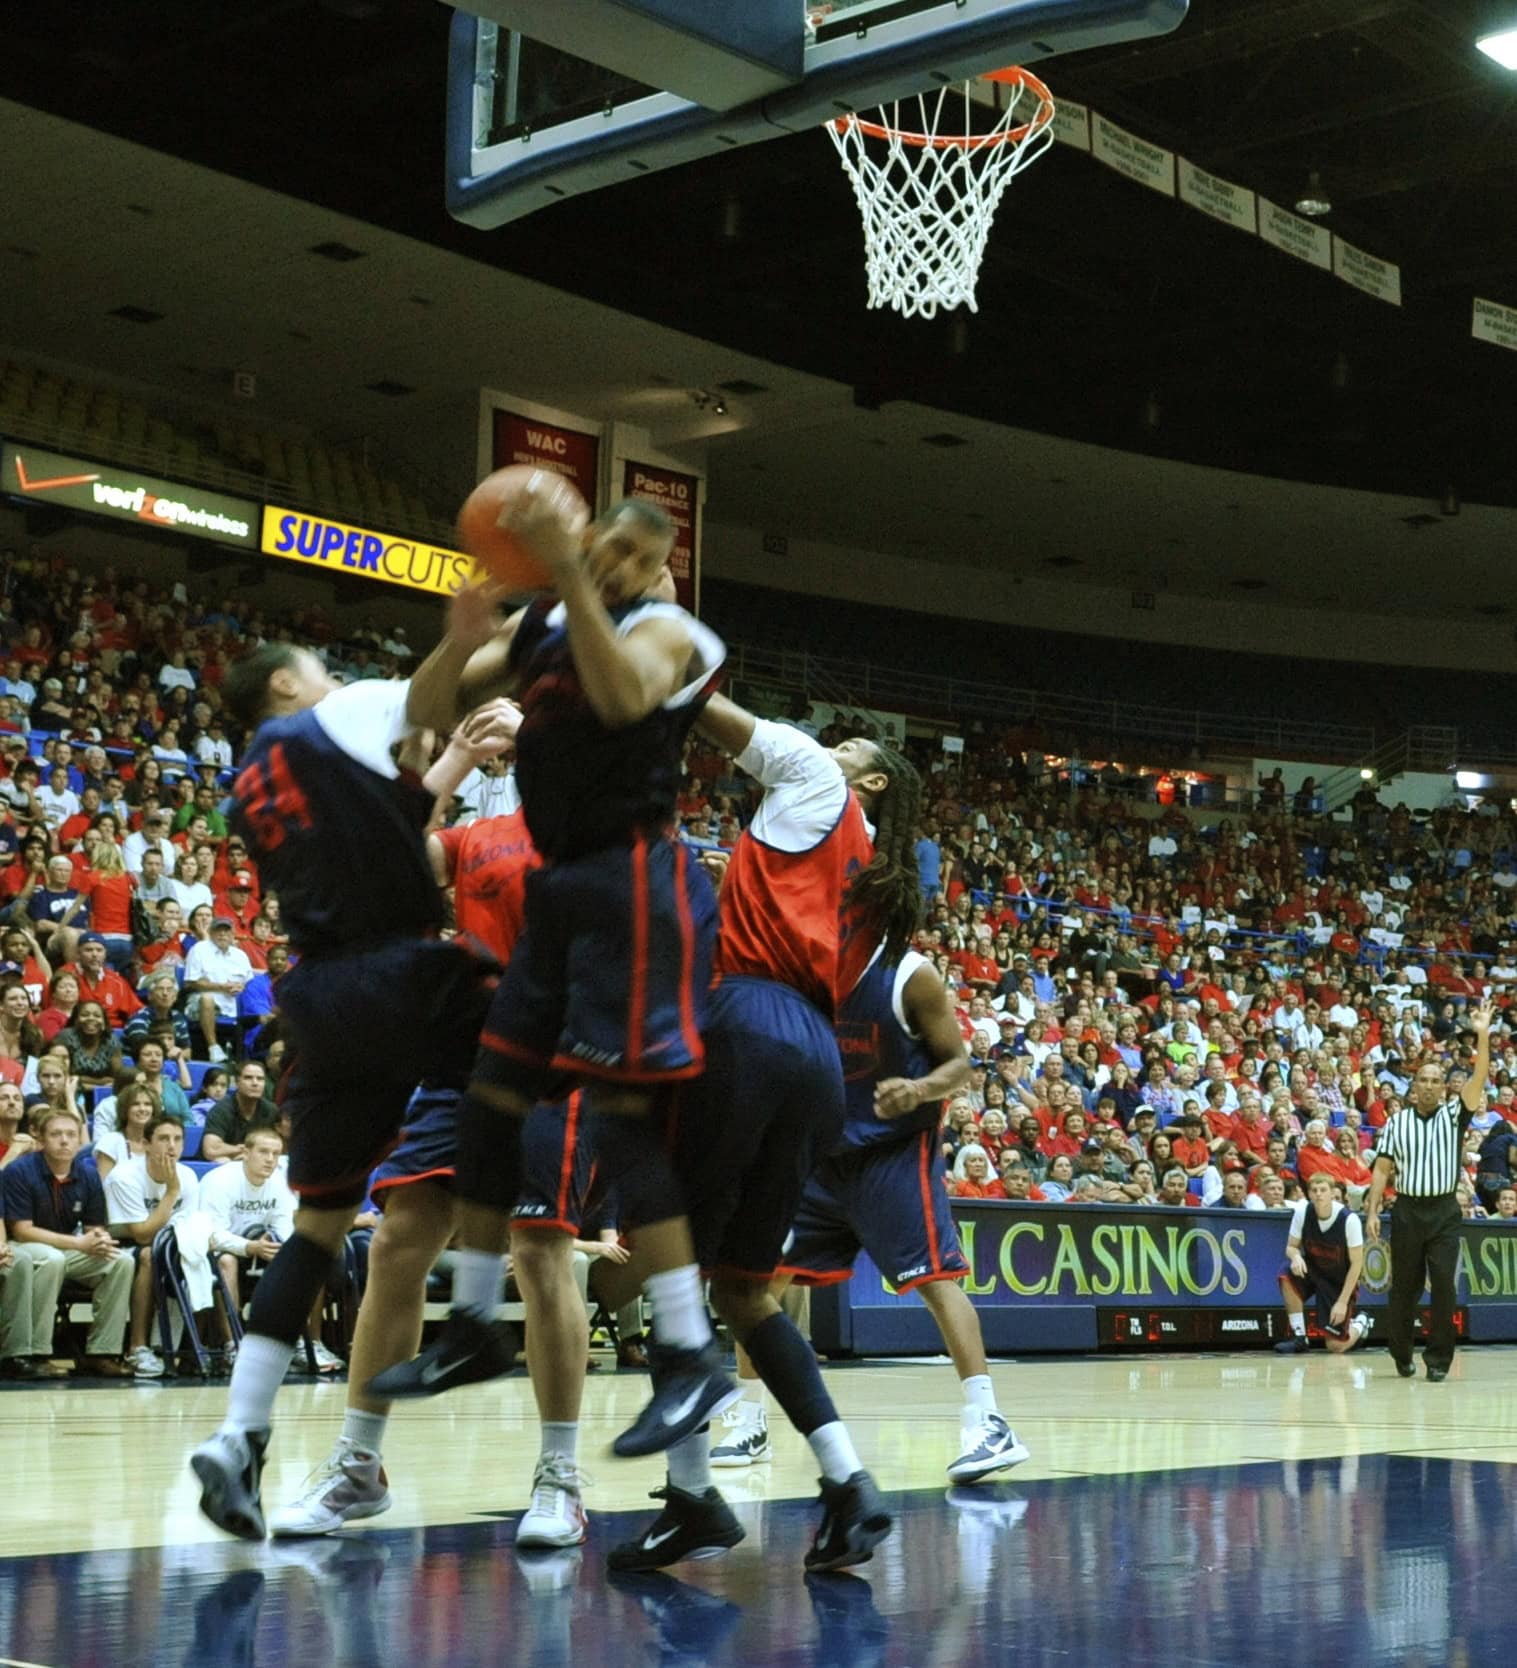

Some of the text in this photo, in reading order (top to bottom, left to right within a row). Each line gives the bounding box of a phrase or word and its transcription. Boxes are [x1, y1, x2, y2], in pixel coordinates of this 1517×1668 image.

[526, 429, 567, 455] WAC
[634, 472, 688, 499] Pac-10
[275, 515, 470, 594] SUPERCUTS
[999, 1222, 1249, 1296] CASINOS
[1221, 1320, 1259, 1331] ARIZONA
